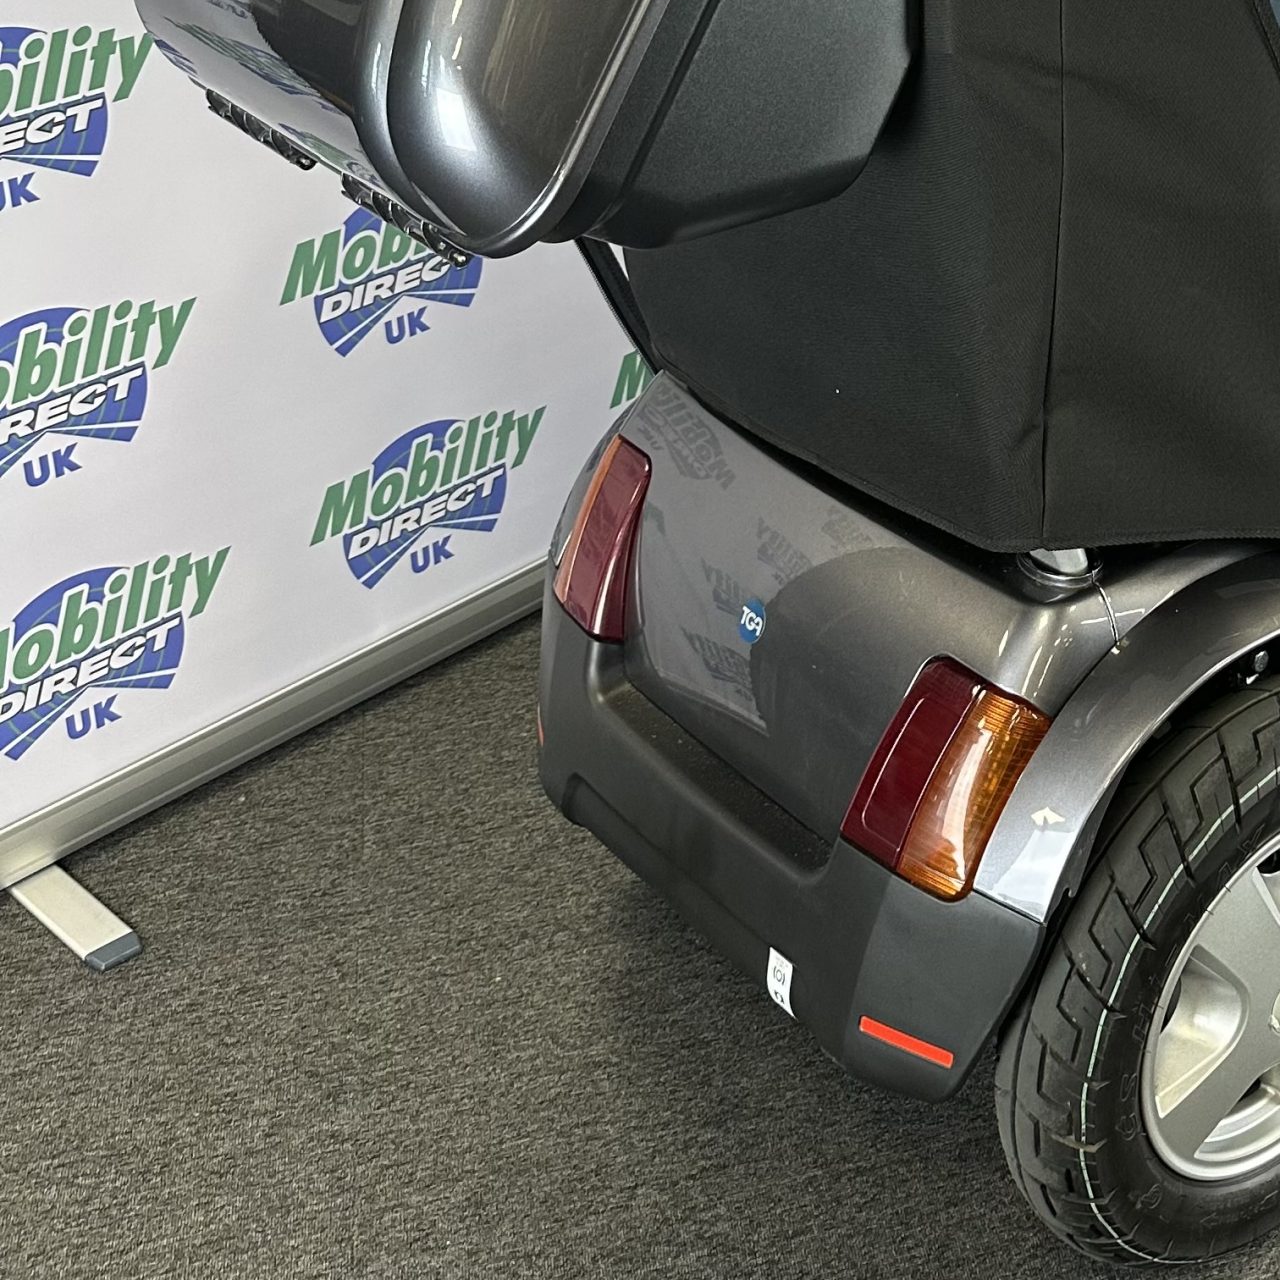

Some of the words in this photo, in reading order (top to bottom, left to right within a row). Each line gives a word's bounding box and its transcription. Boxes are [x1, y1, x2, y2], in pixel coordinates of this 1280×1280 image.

[0, 26, 155, 115] ility
[0, 99, 103, 154] ECT
[320, 256, 450, 323] DIREC
[0, 297, 197, 404] bility
[385, 306, 430, 345] UK
[0, 367, 143, 445] RECT
[23, 442, 83, 487] UK
[310, 406, 547, 546] Mobility
[348, 468, 505, 559] DIRECT
[410, 535, 455, 573] UK
[0, 545, 232, 689] obility
[740, 606, 763, 636] TGA
[66, 694, 122, 739] UK
